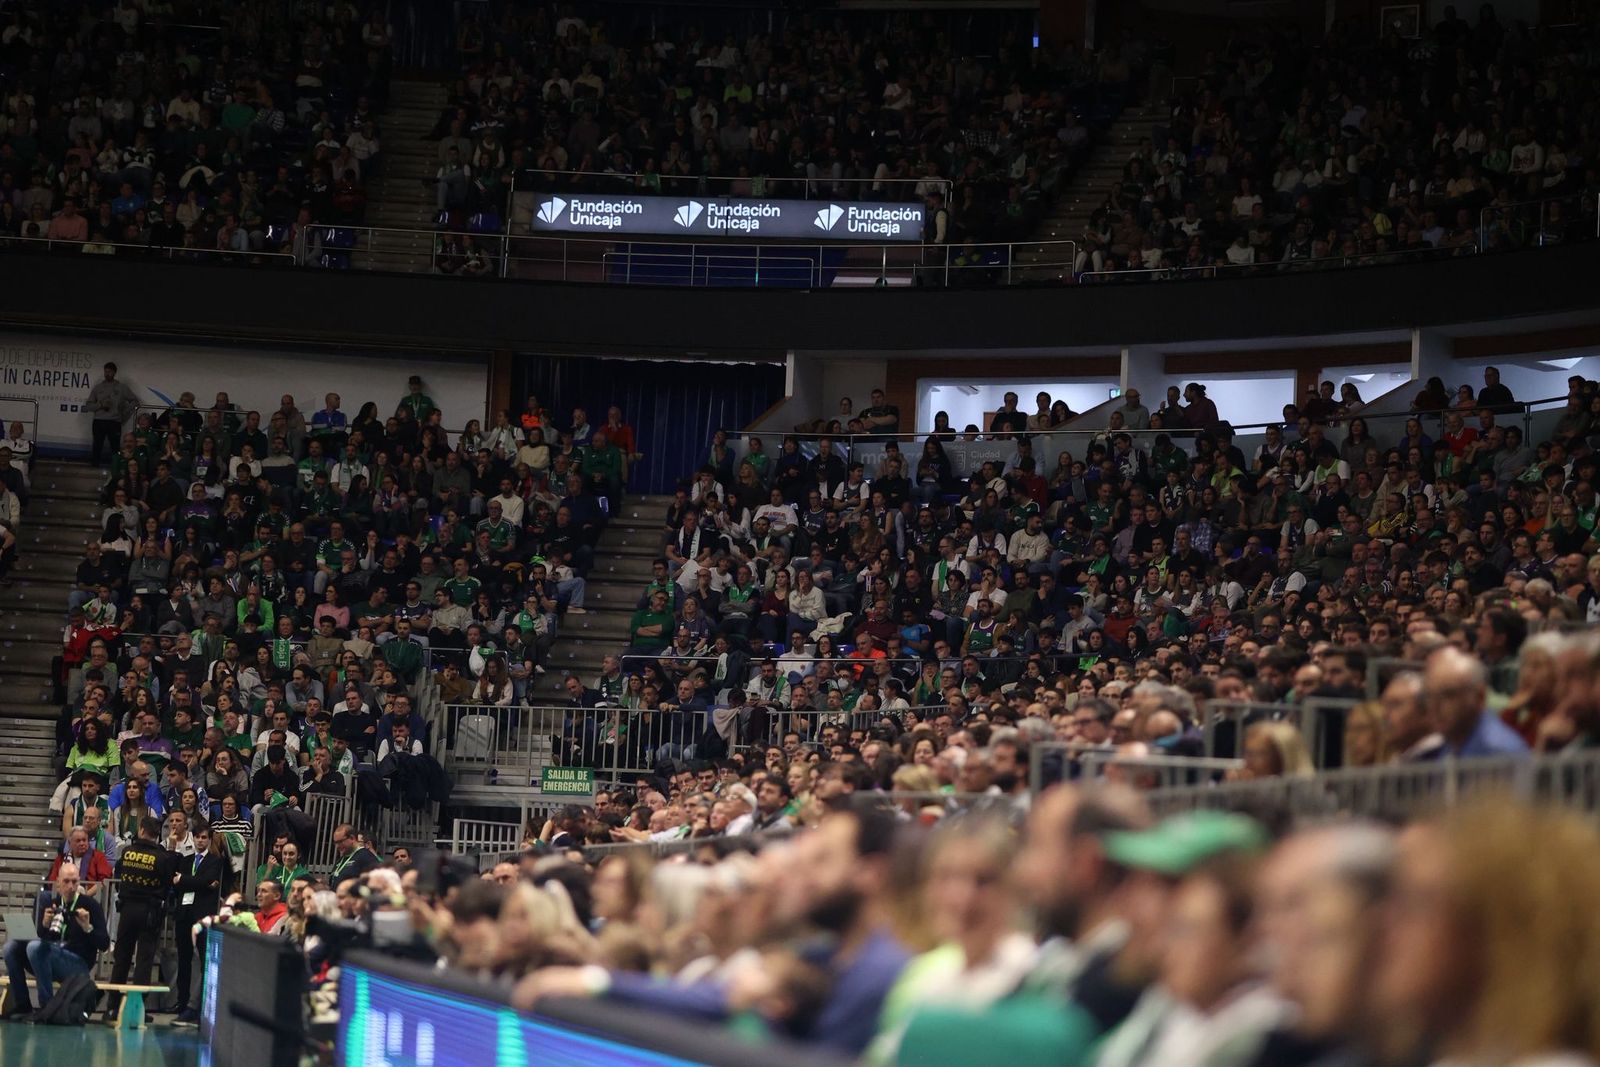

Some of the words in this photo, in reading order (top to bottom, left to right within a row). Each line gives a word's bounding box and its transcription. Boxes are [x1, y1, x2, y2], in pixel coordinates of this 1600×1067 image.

[570, 199, 643, 214] Fundación
[707, 203, 781, 217] Fundación
[848, 206, 922, 221] Fundación
[570, 212, 622, 229] Unicaja
[707, 215, 760, 232] Unicaja
[848, 219, 901, 237] Unicaja
[8, 348, 24, 365] DE
[28, 349, 92, 369] DEPORTES
[23, 368, 90, 389] CARPENA
[970, 450, 1000, 458] Ciudad
[548, 769, 575, 780] SALIDA
[577, 770, 588, 780] DE
[543, 781, 590, 792] EMERGENCIA
[124, 850, 156, 865] COFER
